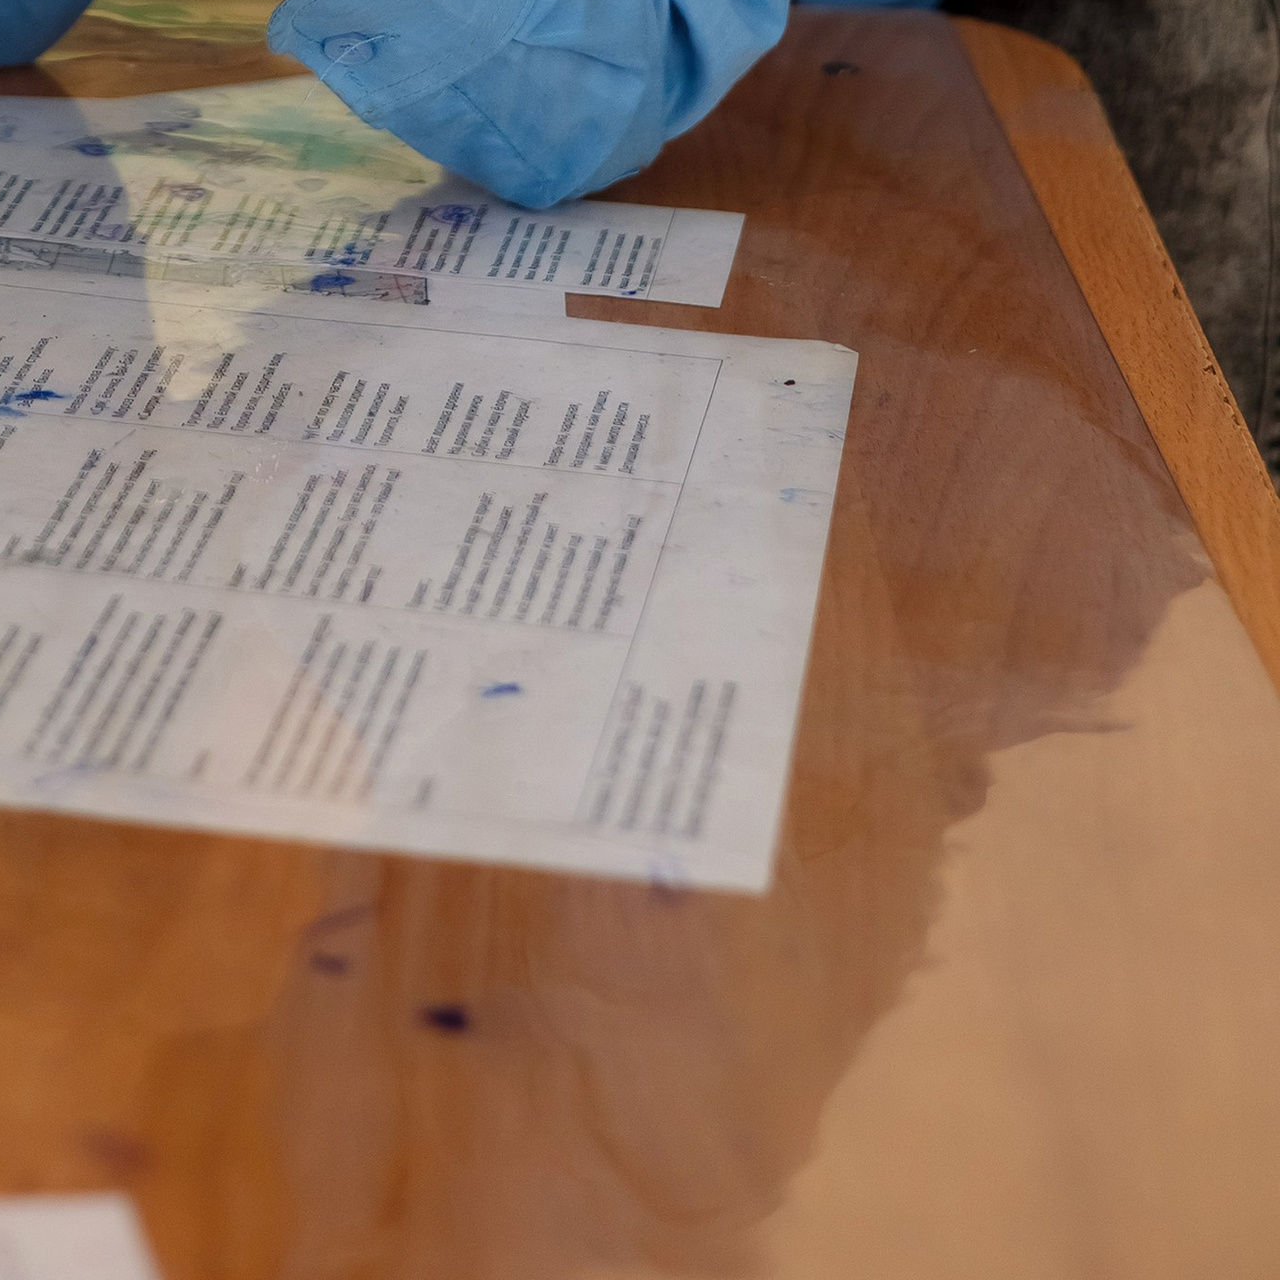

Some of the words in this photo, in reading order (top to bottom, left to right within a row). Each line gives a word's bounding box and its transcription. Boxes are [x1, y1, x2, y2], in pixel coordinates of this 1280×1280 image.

[14, 363, 33, 382] летом
[25, 336, 53, 364] стройная,
[268, 352, 287, 367] волк,
[32, 368, 55, 384] была.
[230, 371, 250, 392] скакал.
[253, 366, 277, 395] сердитый
[328, 370, 351, 394] частому
[63, 393, 89, 415] Метель
[85, 370, 103, 385] пела
[98, 377, 125, 399] ёлочка,
[111, 397, 135, 419] Мороз
[126, 372, 150, 398] снежком
[154, 385, 167, 394] не
[181, 399, 210, 427] Трусишка
[200, 382, 219, 400] зайка
[211, 352, 236, 382] серенький
[213, 390, 239, 416] ёлочкой
[244, 395, 264, 411] волк,
[254, 410, 279, 434] Рысцою
[270, 382, 293, 411] пробегал.
[316, 407, 329, 416] по
[321, 393, 340, 408] лесу
[325, 429, 345, 442] Под
[335, 402, 357, 429] полозом
[348, 379, 368, 403] скрипит
[464, 394, 484, 422] мужичок
[591, 389, 613, 414] пришла,
[206, 416, 226, 429] Под
[230, 410, 254, 432] Порою
[306, 415, 325, 430] Снег
[349, 417, 375, 446] Лошадка
[366, 383, 391, 418] мохноногая
[373, 415, 403, 447] Торопится,
[388, 395, 410, 415] бежит.
[421, 435, 441, 454] Везёт
[432, 410, 453, 437] лошадка
[444, 382, 465, 411] дровенки
[487, 410, 505, 427] нашу
[587, 413, 600, 427] нам
[612, 402, 629, 427] радости
[453, 421, 473, 447] дровнях
[483, 427, 495, 436] он
[503, 427, 521, 448] самый
[542, 445, 565, 467] Теперь
[560, 403, 583, 433] нарядная,
[606, 425, 622, 445] много
[446, 445, 463, 455] На
[470, 435, 492, 458] Срубил
[494, 447, 515, 460] Под
[575, 431, 595, 460] праздник
[599, 445, 617, 466] много,
[617, 442, 641, 475] Детишкам
[631, 414, 651, 443] принесла.
[569, 459, 585, 469] На
